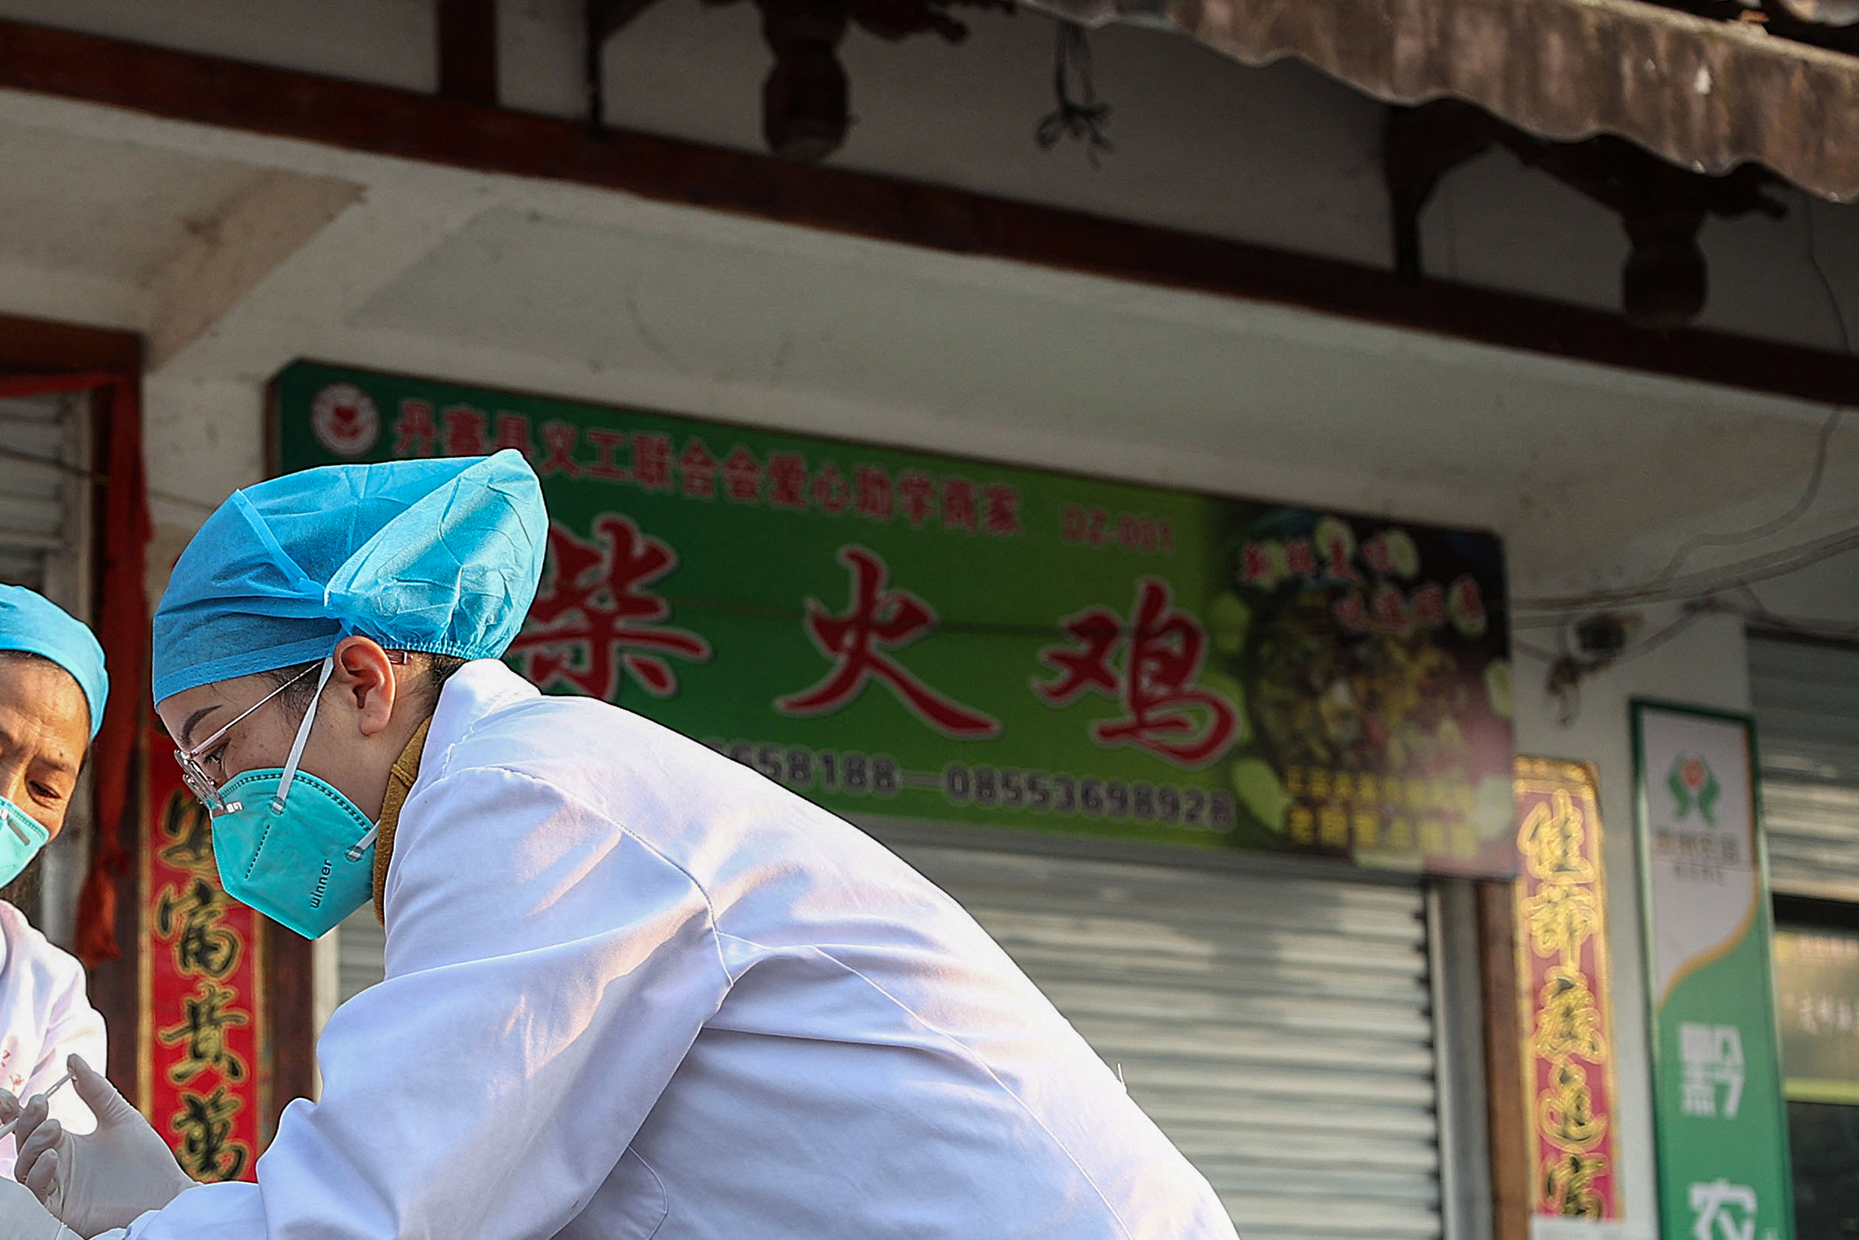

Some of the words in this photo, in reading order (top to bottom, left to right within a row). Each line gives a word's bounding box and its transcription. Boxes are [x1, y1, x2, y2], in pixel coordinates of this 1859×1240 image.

[505, 514, 1239, 762] 柴火鸡
[310, 859, 333, 909] winner
